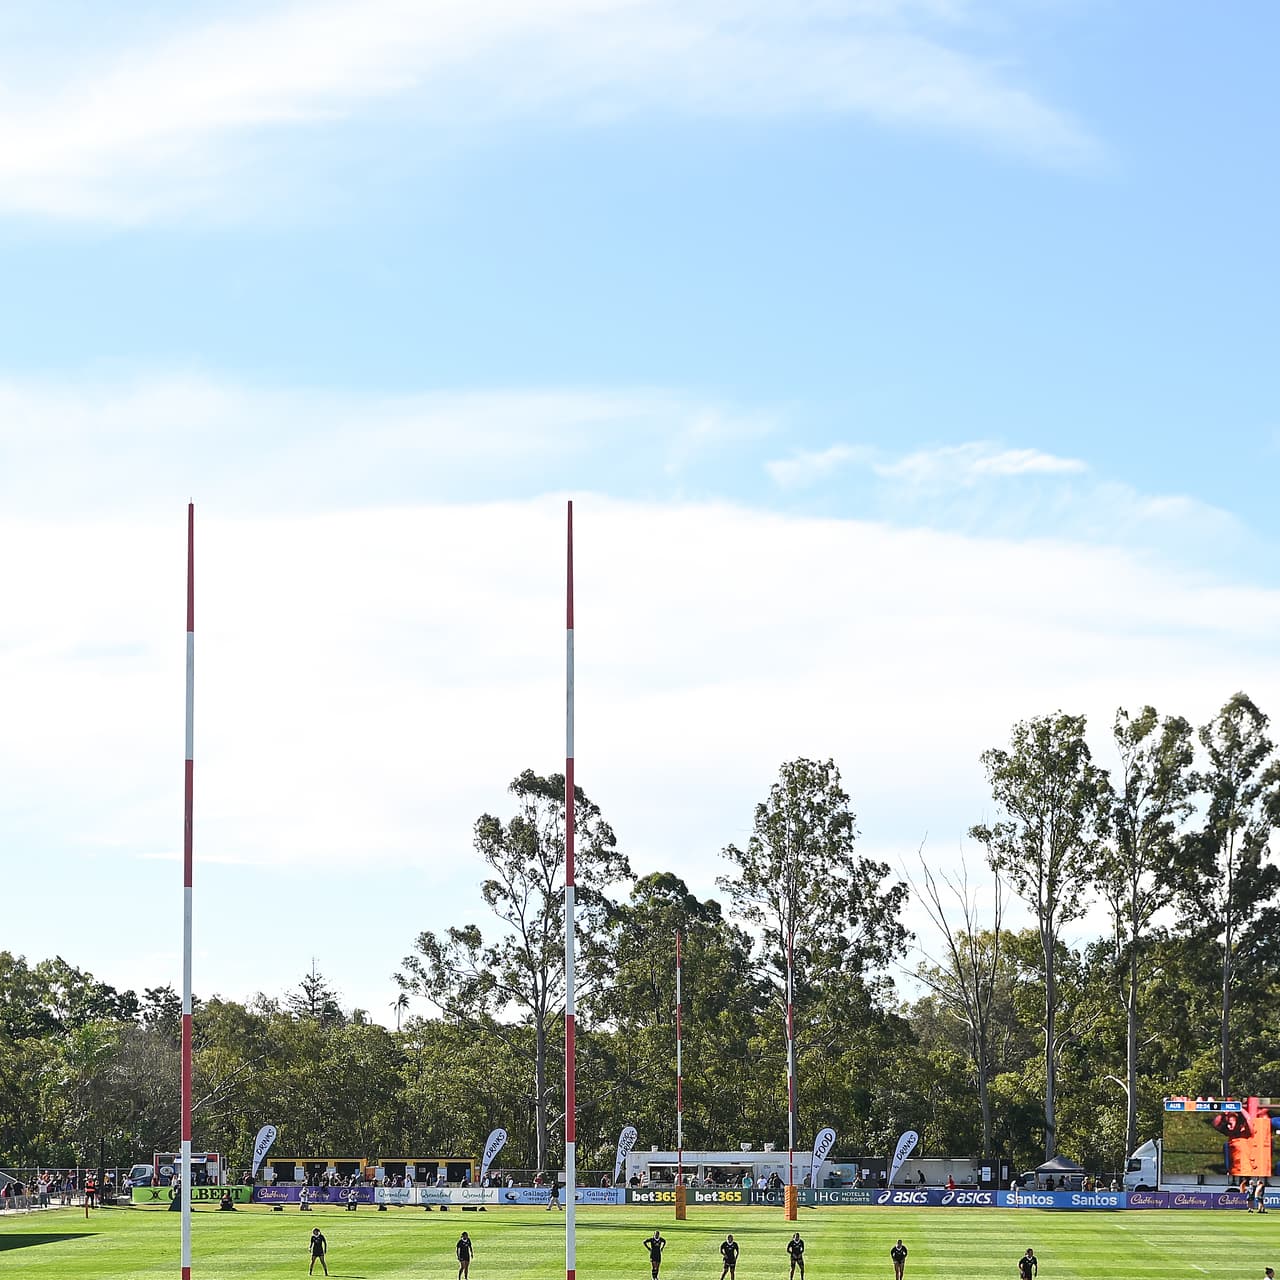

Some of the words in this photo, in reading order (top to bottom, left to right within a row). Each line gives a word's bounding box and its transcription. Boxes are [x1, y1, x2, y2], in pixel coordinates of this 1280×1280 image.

[255, 1128, 275, 1157] DRINKS
[486, 1131, 505, 1159] DRINKS
[814, 1131, 833, 1160] FOOD
[896, 1133, 917, 1161] DRINKS
[168, 1188, 242, 1201] GLBERT
[257, 1188, 289, 1200] Cadbury
[377, 1188, 411, 1199] Queensland
[420, 1189, 452, 1200] Queensland
[462, 1189, 494, 1200] Queensland
[632, 1190, 677, 1202] bet365
[695, 1191, 742, 1202] bet365
[751, 1191, 776, 1202] IHG
[814, 1191, 840, 1202] IHG
[1006, 1193, 1054, 1206] Santos
[1071, 1194, 1118, 1206] Santos
[1130, 1193, 1163, 1207] Cadbury
[1174, 1193, 1207, 1208] Cadbury
